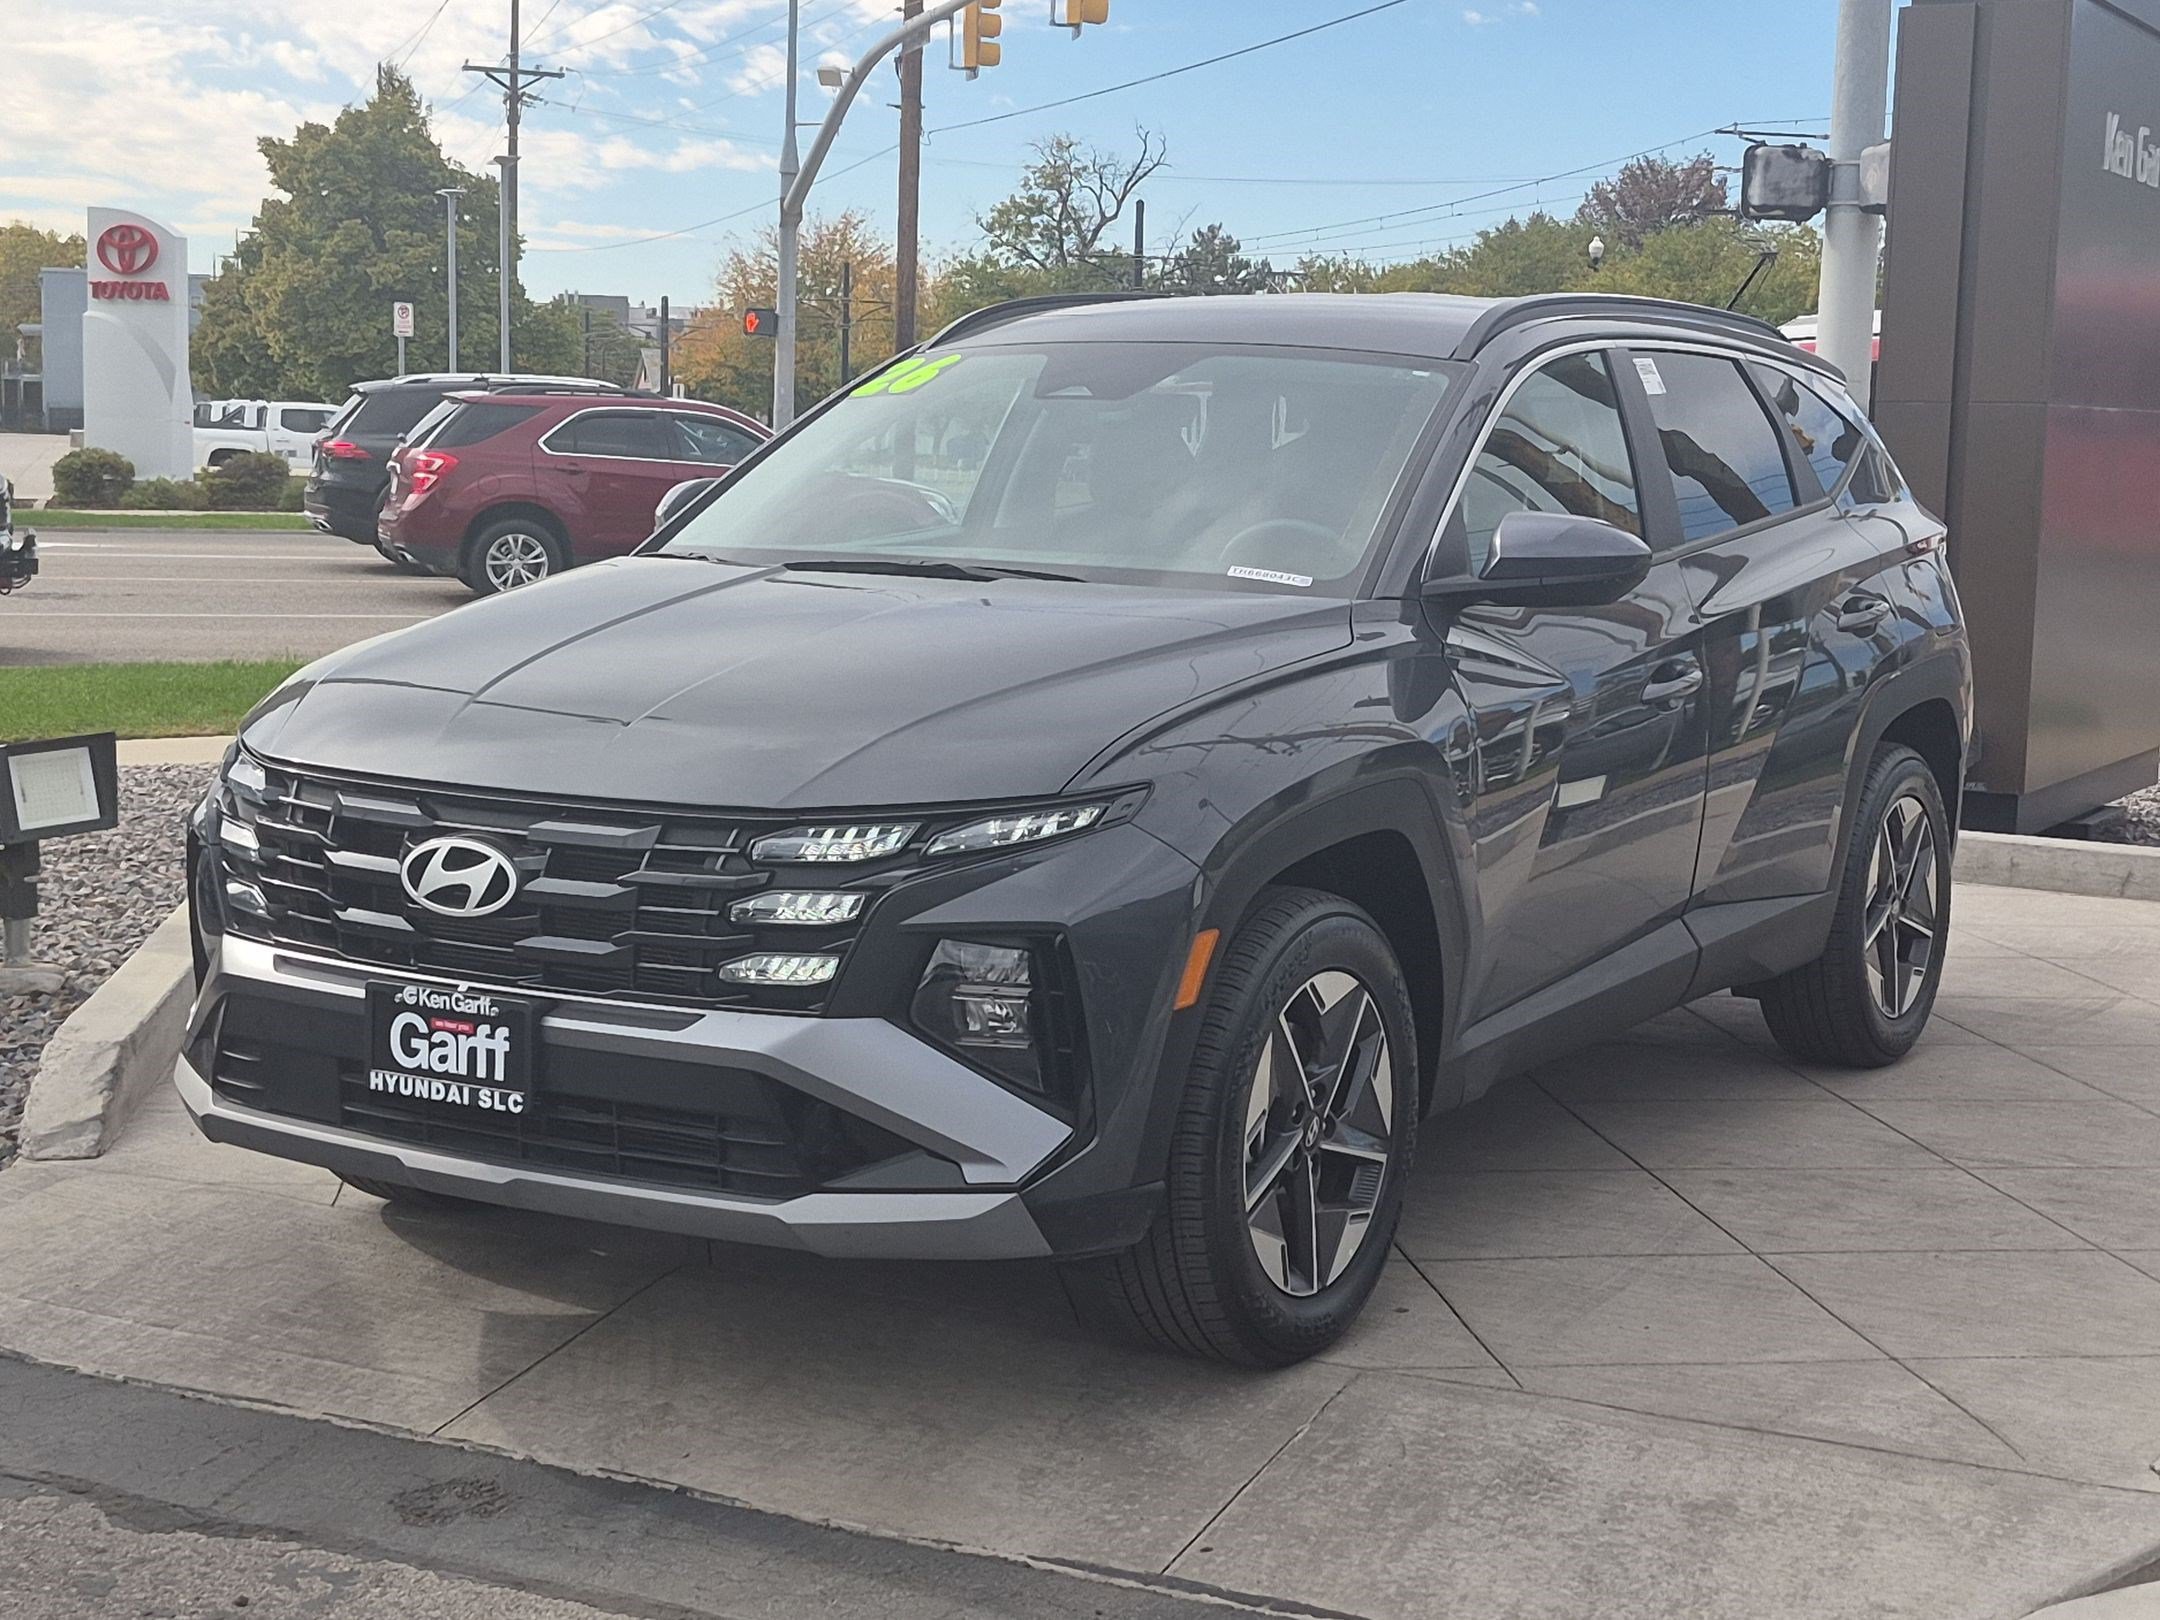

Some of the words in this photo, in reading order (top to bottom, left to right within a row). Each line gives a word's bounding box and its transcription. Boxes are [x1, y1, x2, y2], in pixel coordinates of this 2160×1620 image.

[2103, 111, 2134, 178] Ken
[88, 281, 170, 301] TOYOTA
[418, 987, 450, 1010] Ken
[451, 992, 491, 1016] Garff
[390, 1011, 510, 1082] Garff
[369, 1071, 470, 1106] HYUNDAI
[477, 1089, 524, 1114] SLC
